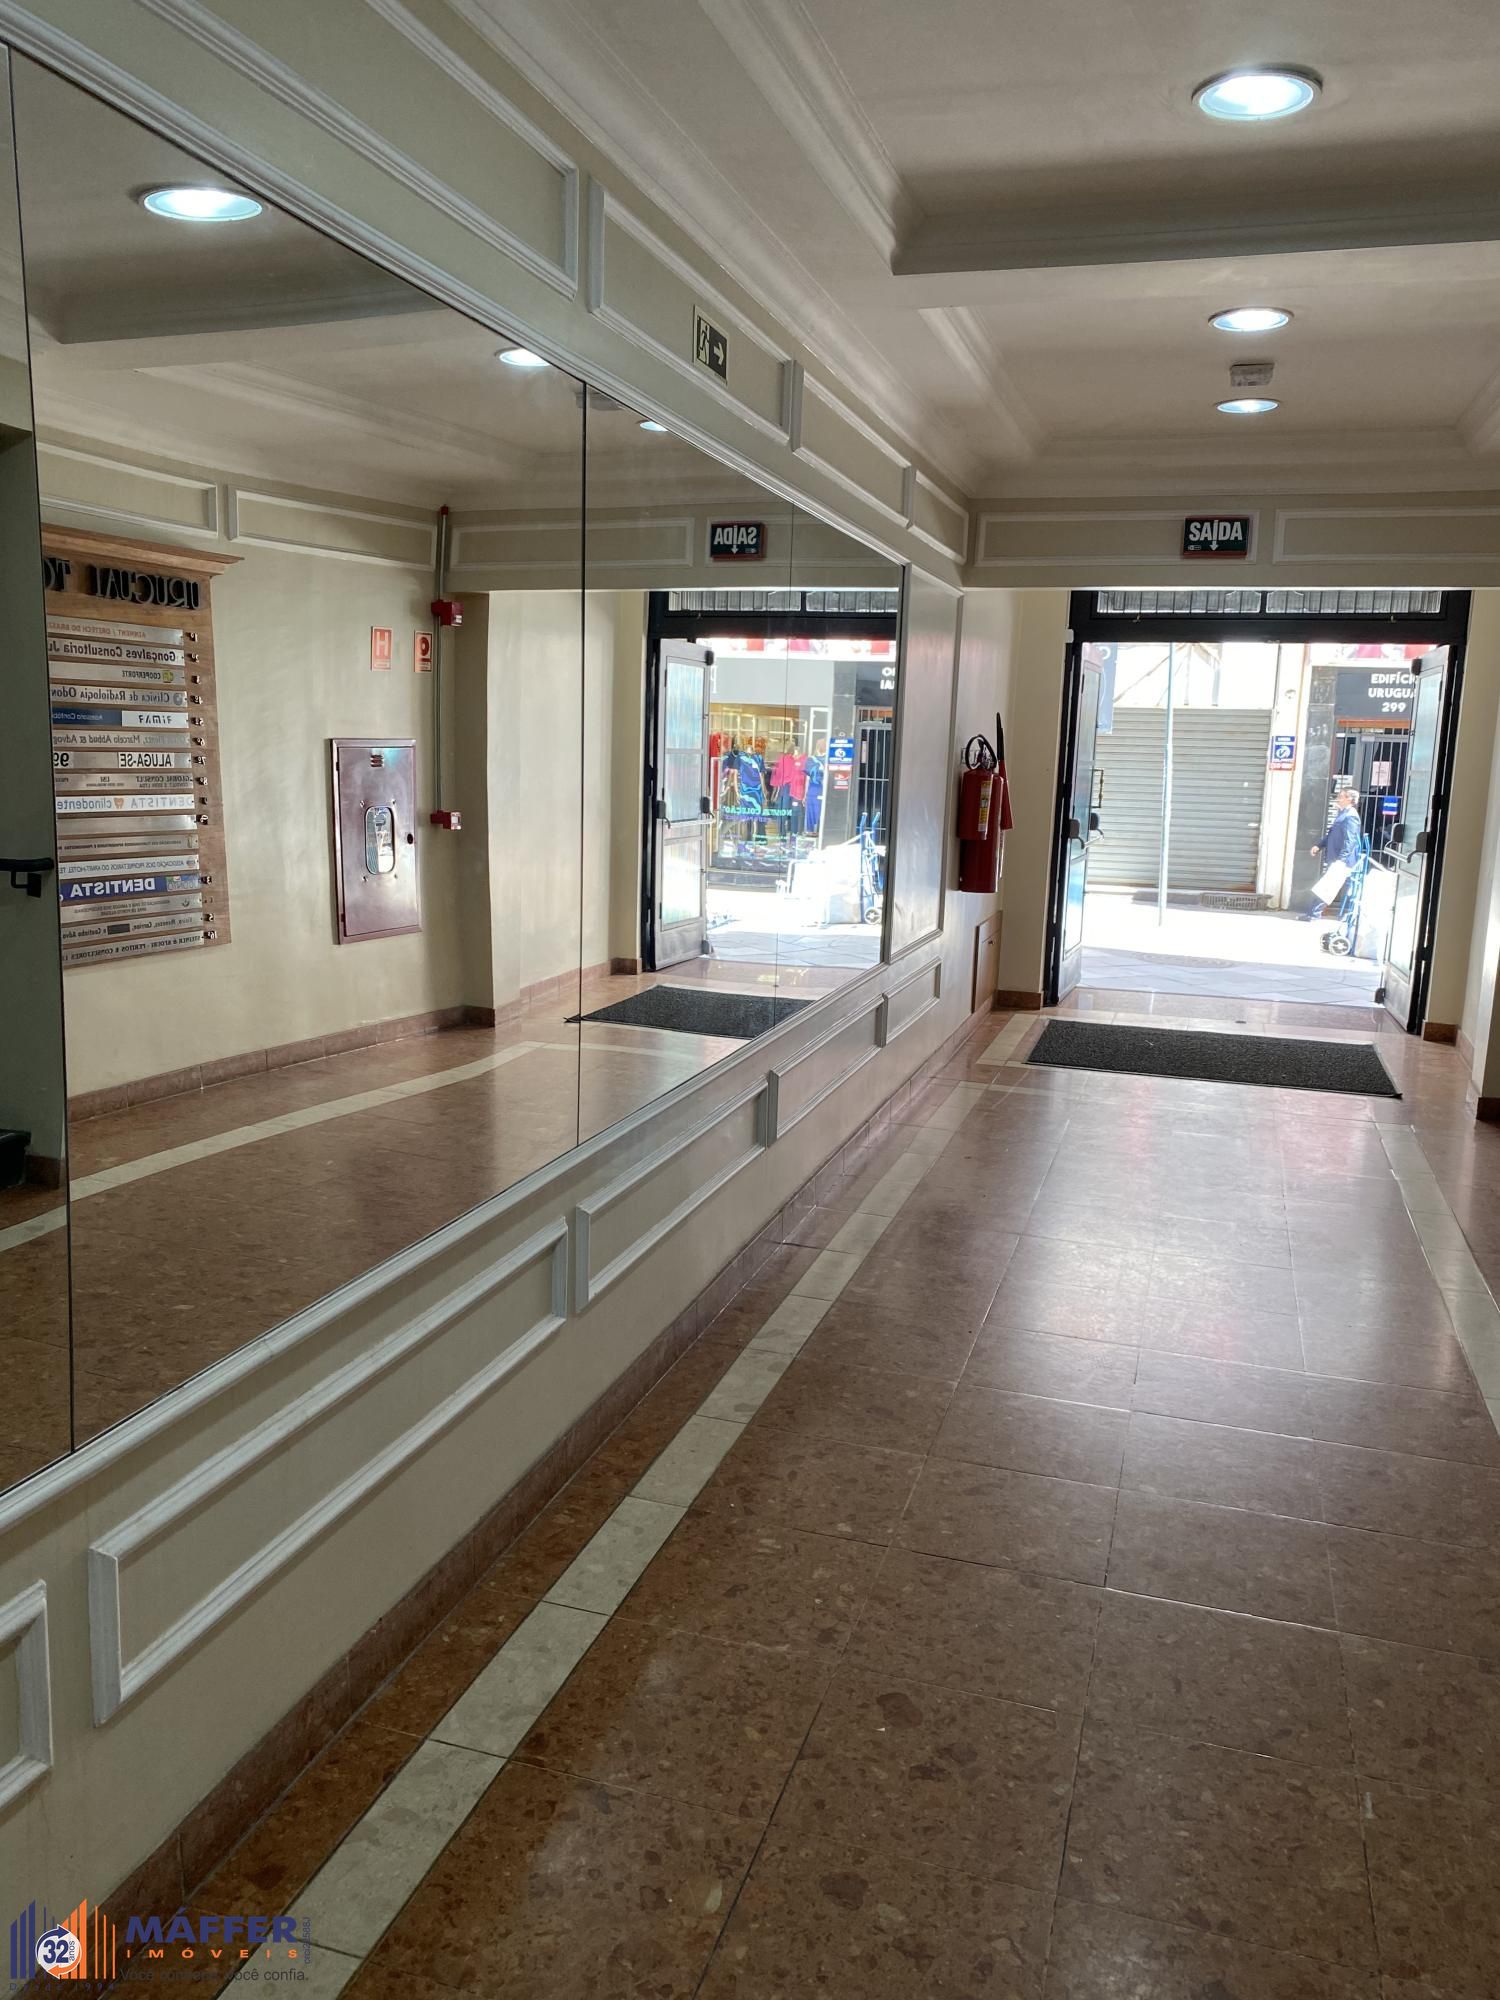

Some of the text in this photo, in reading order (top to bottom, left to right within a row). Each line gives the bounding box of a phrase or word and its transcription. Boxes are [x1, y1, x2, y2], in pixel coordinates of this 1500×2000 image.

[1189, 520, 1243, 541] SAÍDA
[1371, 671, 1415, 685] EDIFÍCI
[1381, 701, 1406, 713] 299
